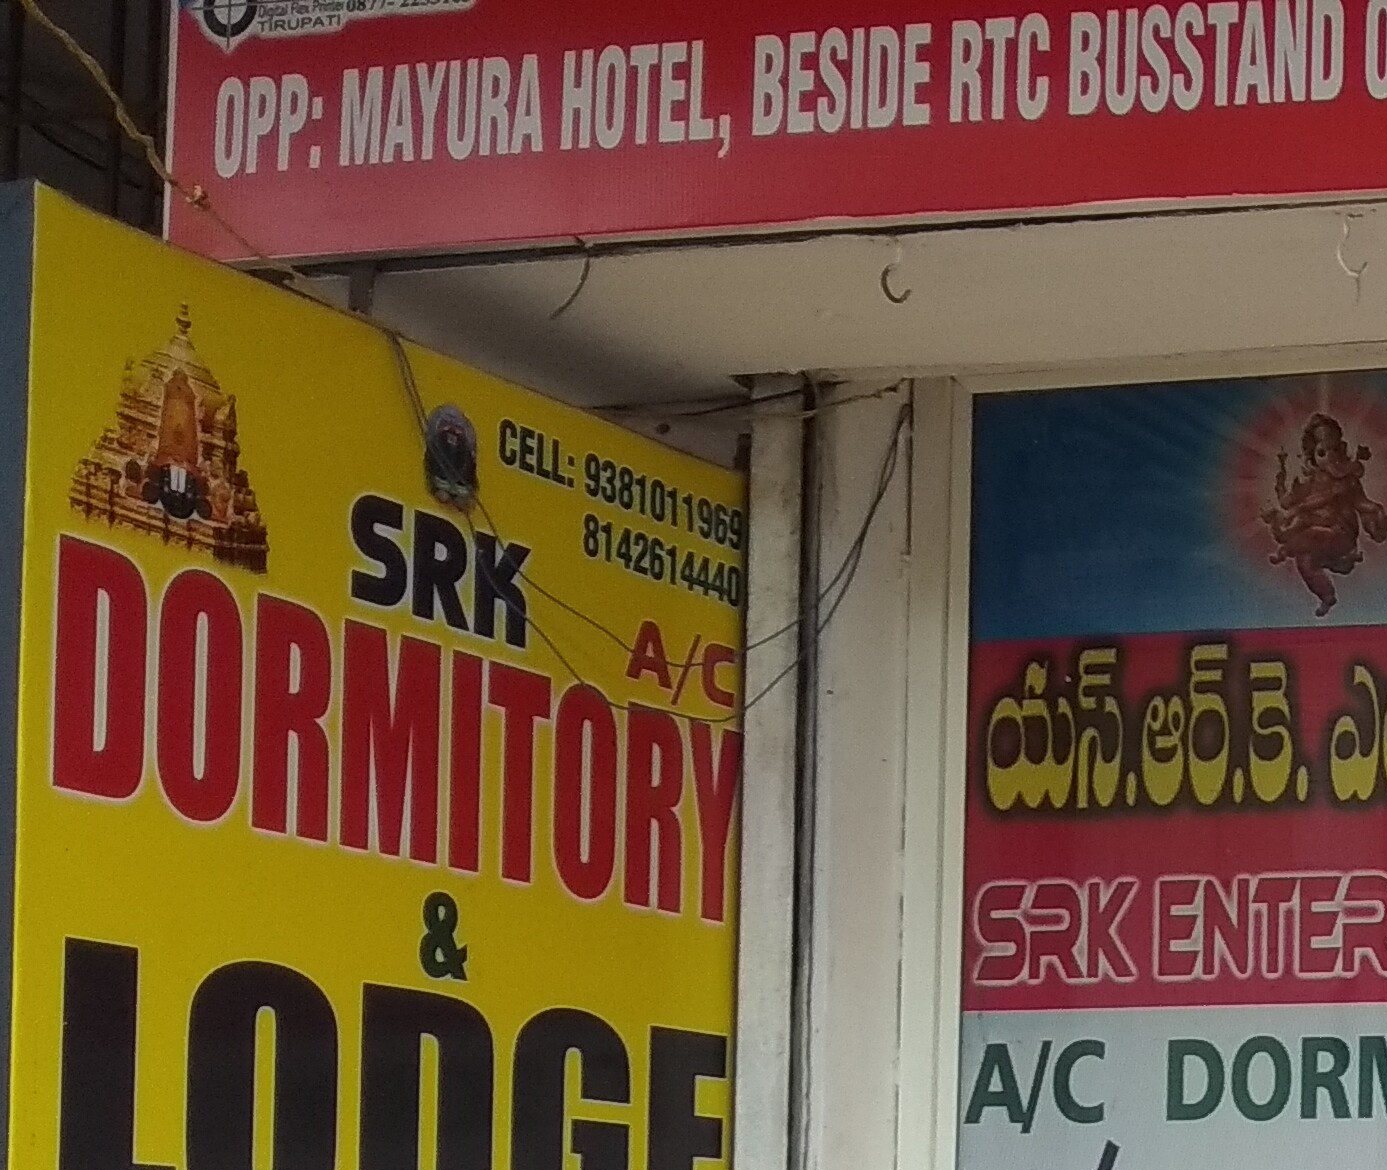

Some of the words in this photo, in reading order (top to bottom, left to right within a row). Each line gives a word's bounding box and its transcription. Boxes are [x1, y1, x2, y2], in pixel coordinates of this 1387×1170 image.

[257, 14, 342, 33] TIRUPATI
[214, 74, 323, 179] OPP:
[339, 53, 544, 167] MAYURA
[560, 39, 732, 158] HOTEL,
[751, 22, 932, 136] BESIDE
[949, 13, 1051, 123] RTC
[1068, 0, 1344, 116] BUSSTAND
[498, 418, 575, 489] CELL:
[584, 452, 742, 551] 9381011969
[350, 493, 532, 648] SRK
[583, 513, 742, 608] 8142614440
[626, 620, 738, 708] A/C
[51, 532, 744, 924] DORMITORY
[418, 891, 469, 982] &
[974, 876, 1137, 985] SRK
[963, 1039, 1107, 1134] A/C
